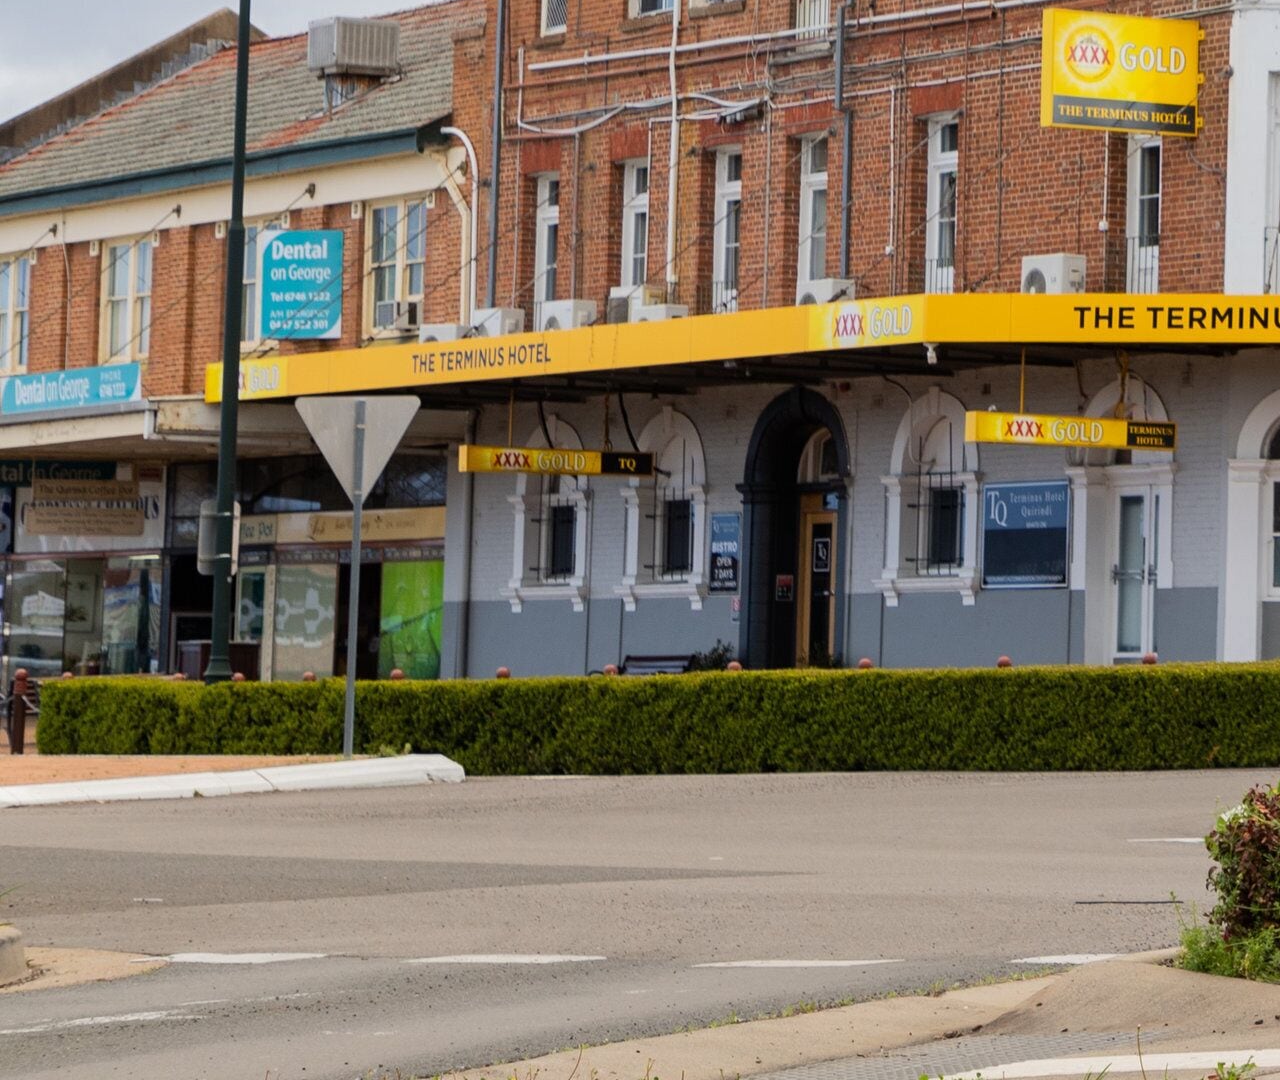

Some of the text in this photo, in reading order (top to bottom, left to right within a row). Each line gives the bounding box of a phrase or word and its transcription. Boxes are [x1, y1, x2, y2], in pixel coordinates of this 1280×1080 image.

[1067, 42, 1186, 75] XXXX GOLD
[1058, 104, 1190, 125] THE TERMINUS HOTEL
[271, 239, 328, 260] Dental
[270, 264, 332, 284] on George
[834, 305, 912, 339] XXXX GOLD
[1073, 306, 1135, 330] THE
[412, 343, 551, 374] THE TERMINUS HOTEL
[15, 374, 90, 405] Dental on George
[1005, 419, 1103, 443] XXXX GOLD
[1129, 425, 1174, 435] TERMINUS
[1136, 436, 1165, 446] HOTEL
[493, 452, 586, 471] XXXX GOLD
[618, 458, 637, 471] TQ
[987, 491, 1065, 527] TQ Terminus Hotel
[711, 542, 738, 553] BISTRO
[716, 557, 732, 567] OPEN
[719, 569, 733, 580] DAYS
